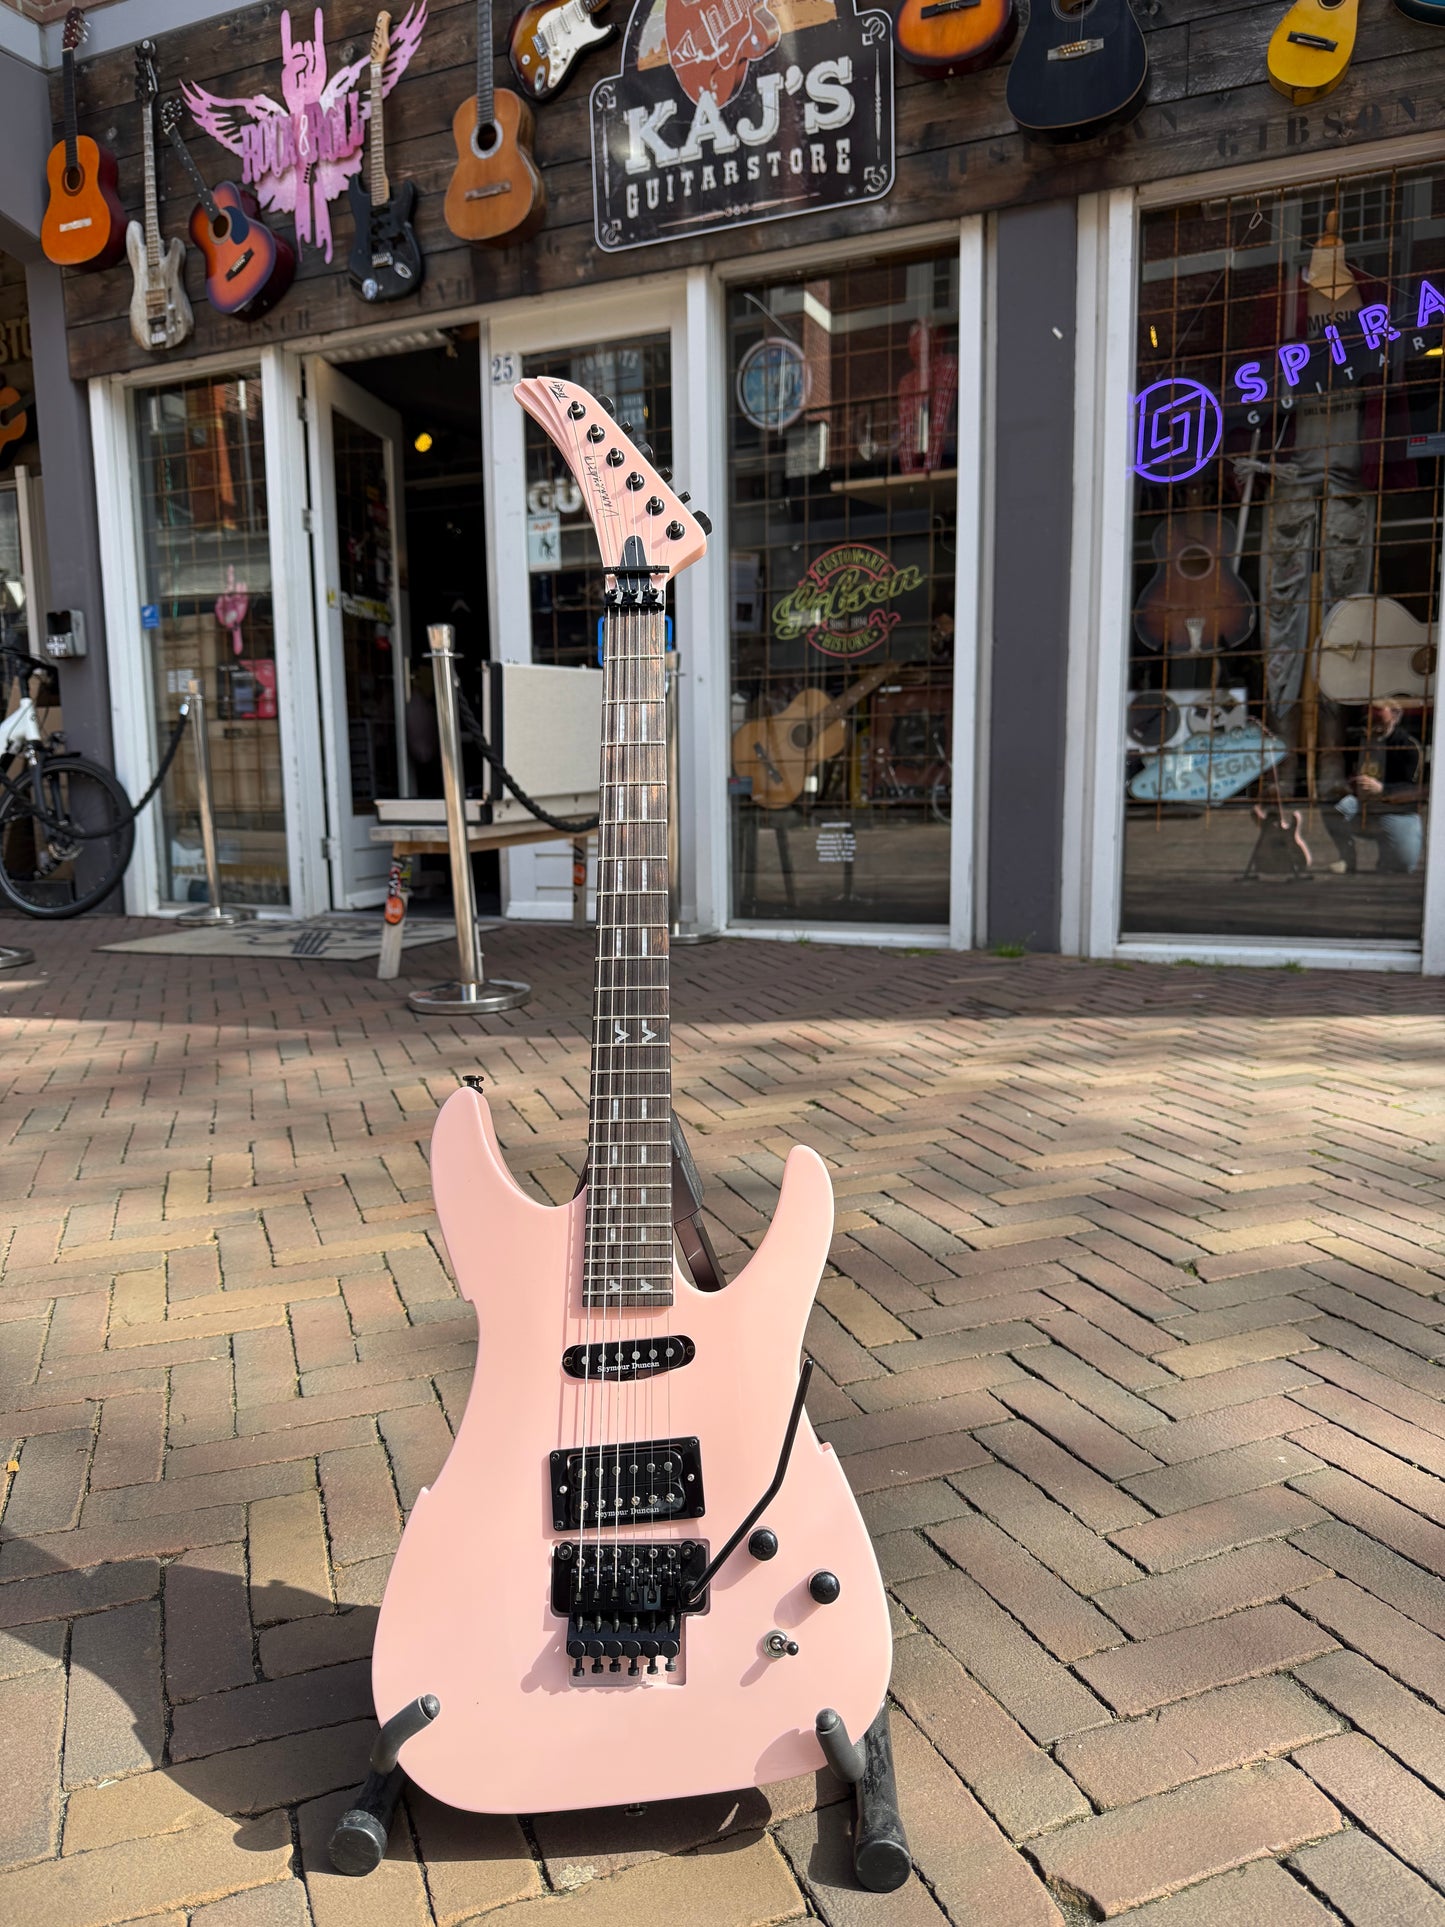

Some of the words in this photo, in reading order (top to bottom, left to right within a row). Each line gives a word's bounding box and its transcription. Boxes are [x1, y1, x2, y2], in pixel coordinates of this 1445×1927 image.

[623, 56, 856, 175] KAJ'S
[626, 138, 852, 218] GUITARSTORE
[492, 356, 514, 381] 25
[597, 1363, 630, 1373] Seymour
[631, 1361, 660, 1370] Duncan
[594, 1509, 629, 1519] Seymour
[630, 1506, 660, 1516] Duncan
